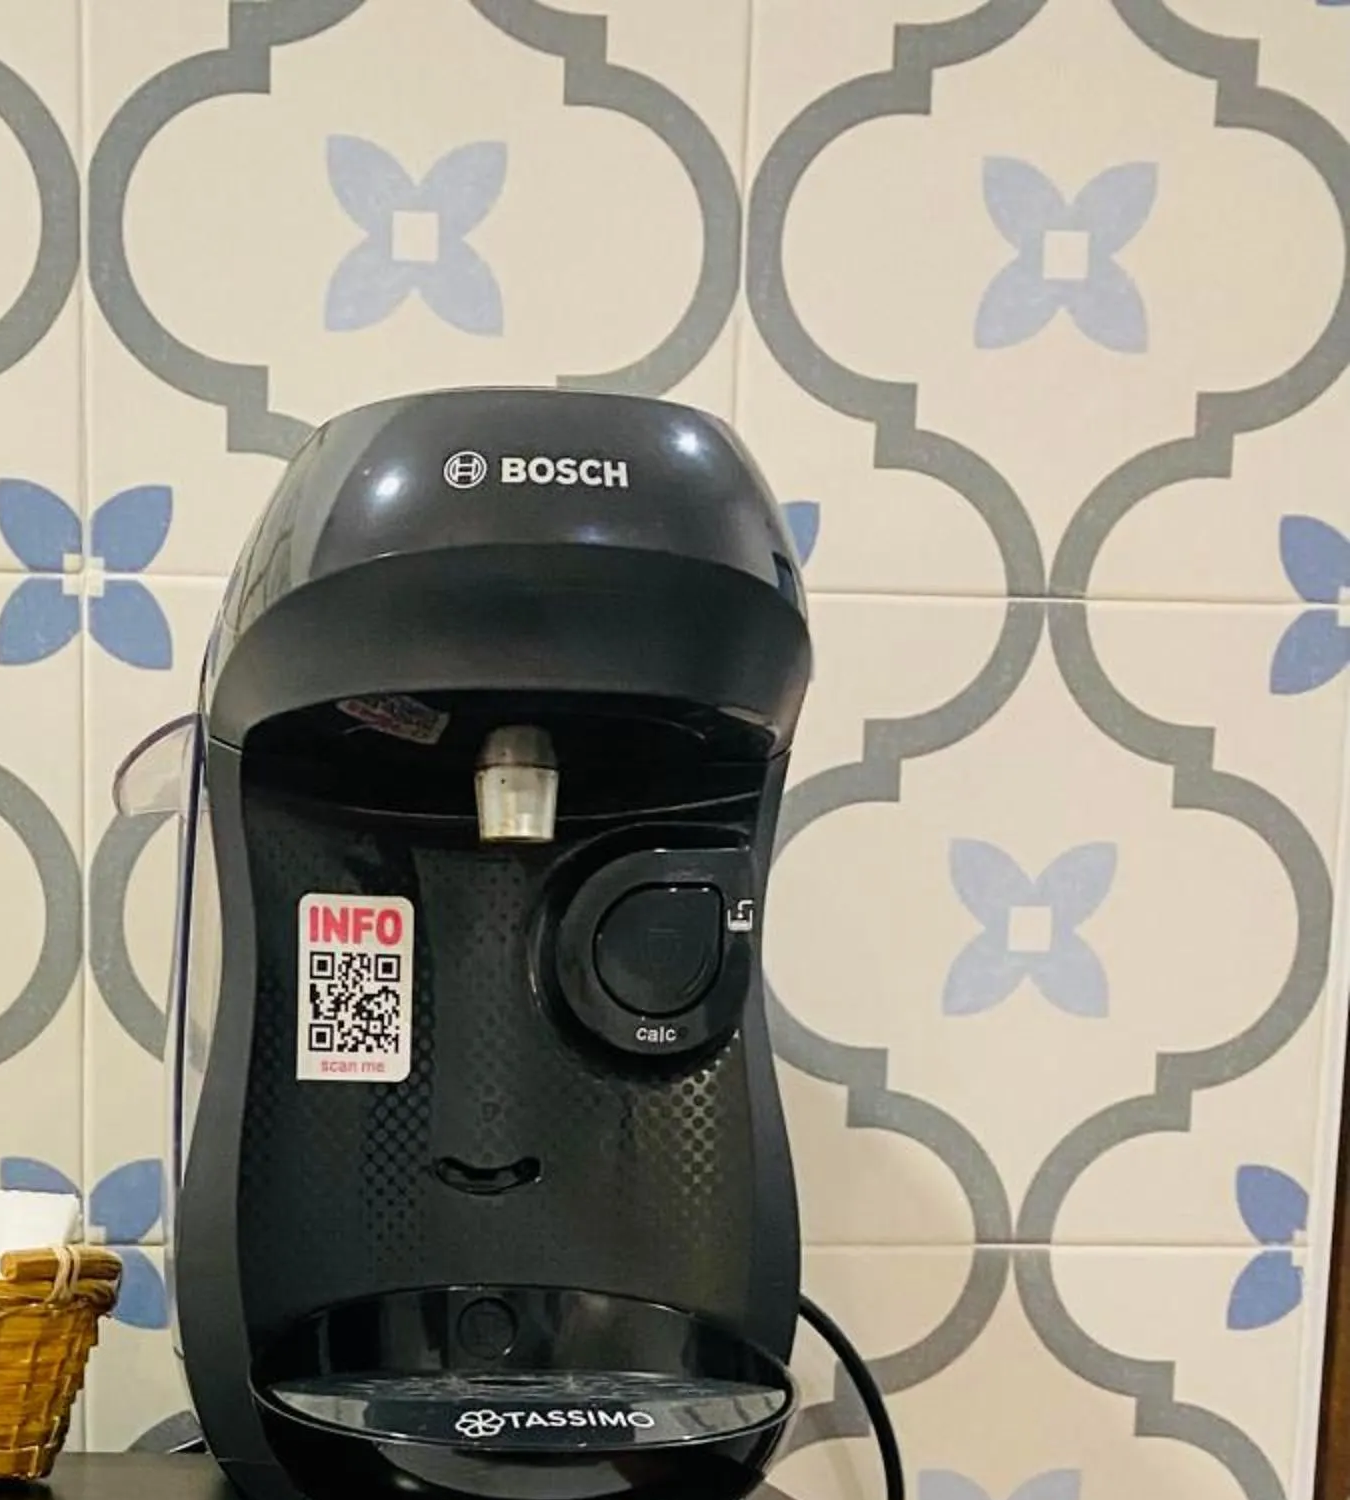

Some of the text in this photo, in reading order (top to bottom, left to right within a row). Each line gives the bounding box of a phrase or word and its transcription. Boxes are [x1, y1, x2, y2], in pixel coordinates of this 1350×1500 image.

[500, 456, 629, 488] BOSCH
[309, 905, 403, 946] INFO
[635, 1026, 677, 1043] calc
[320, 1060, 386, 1073] scan me
[502, 1409, 655, 1429] TASSIMO
